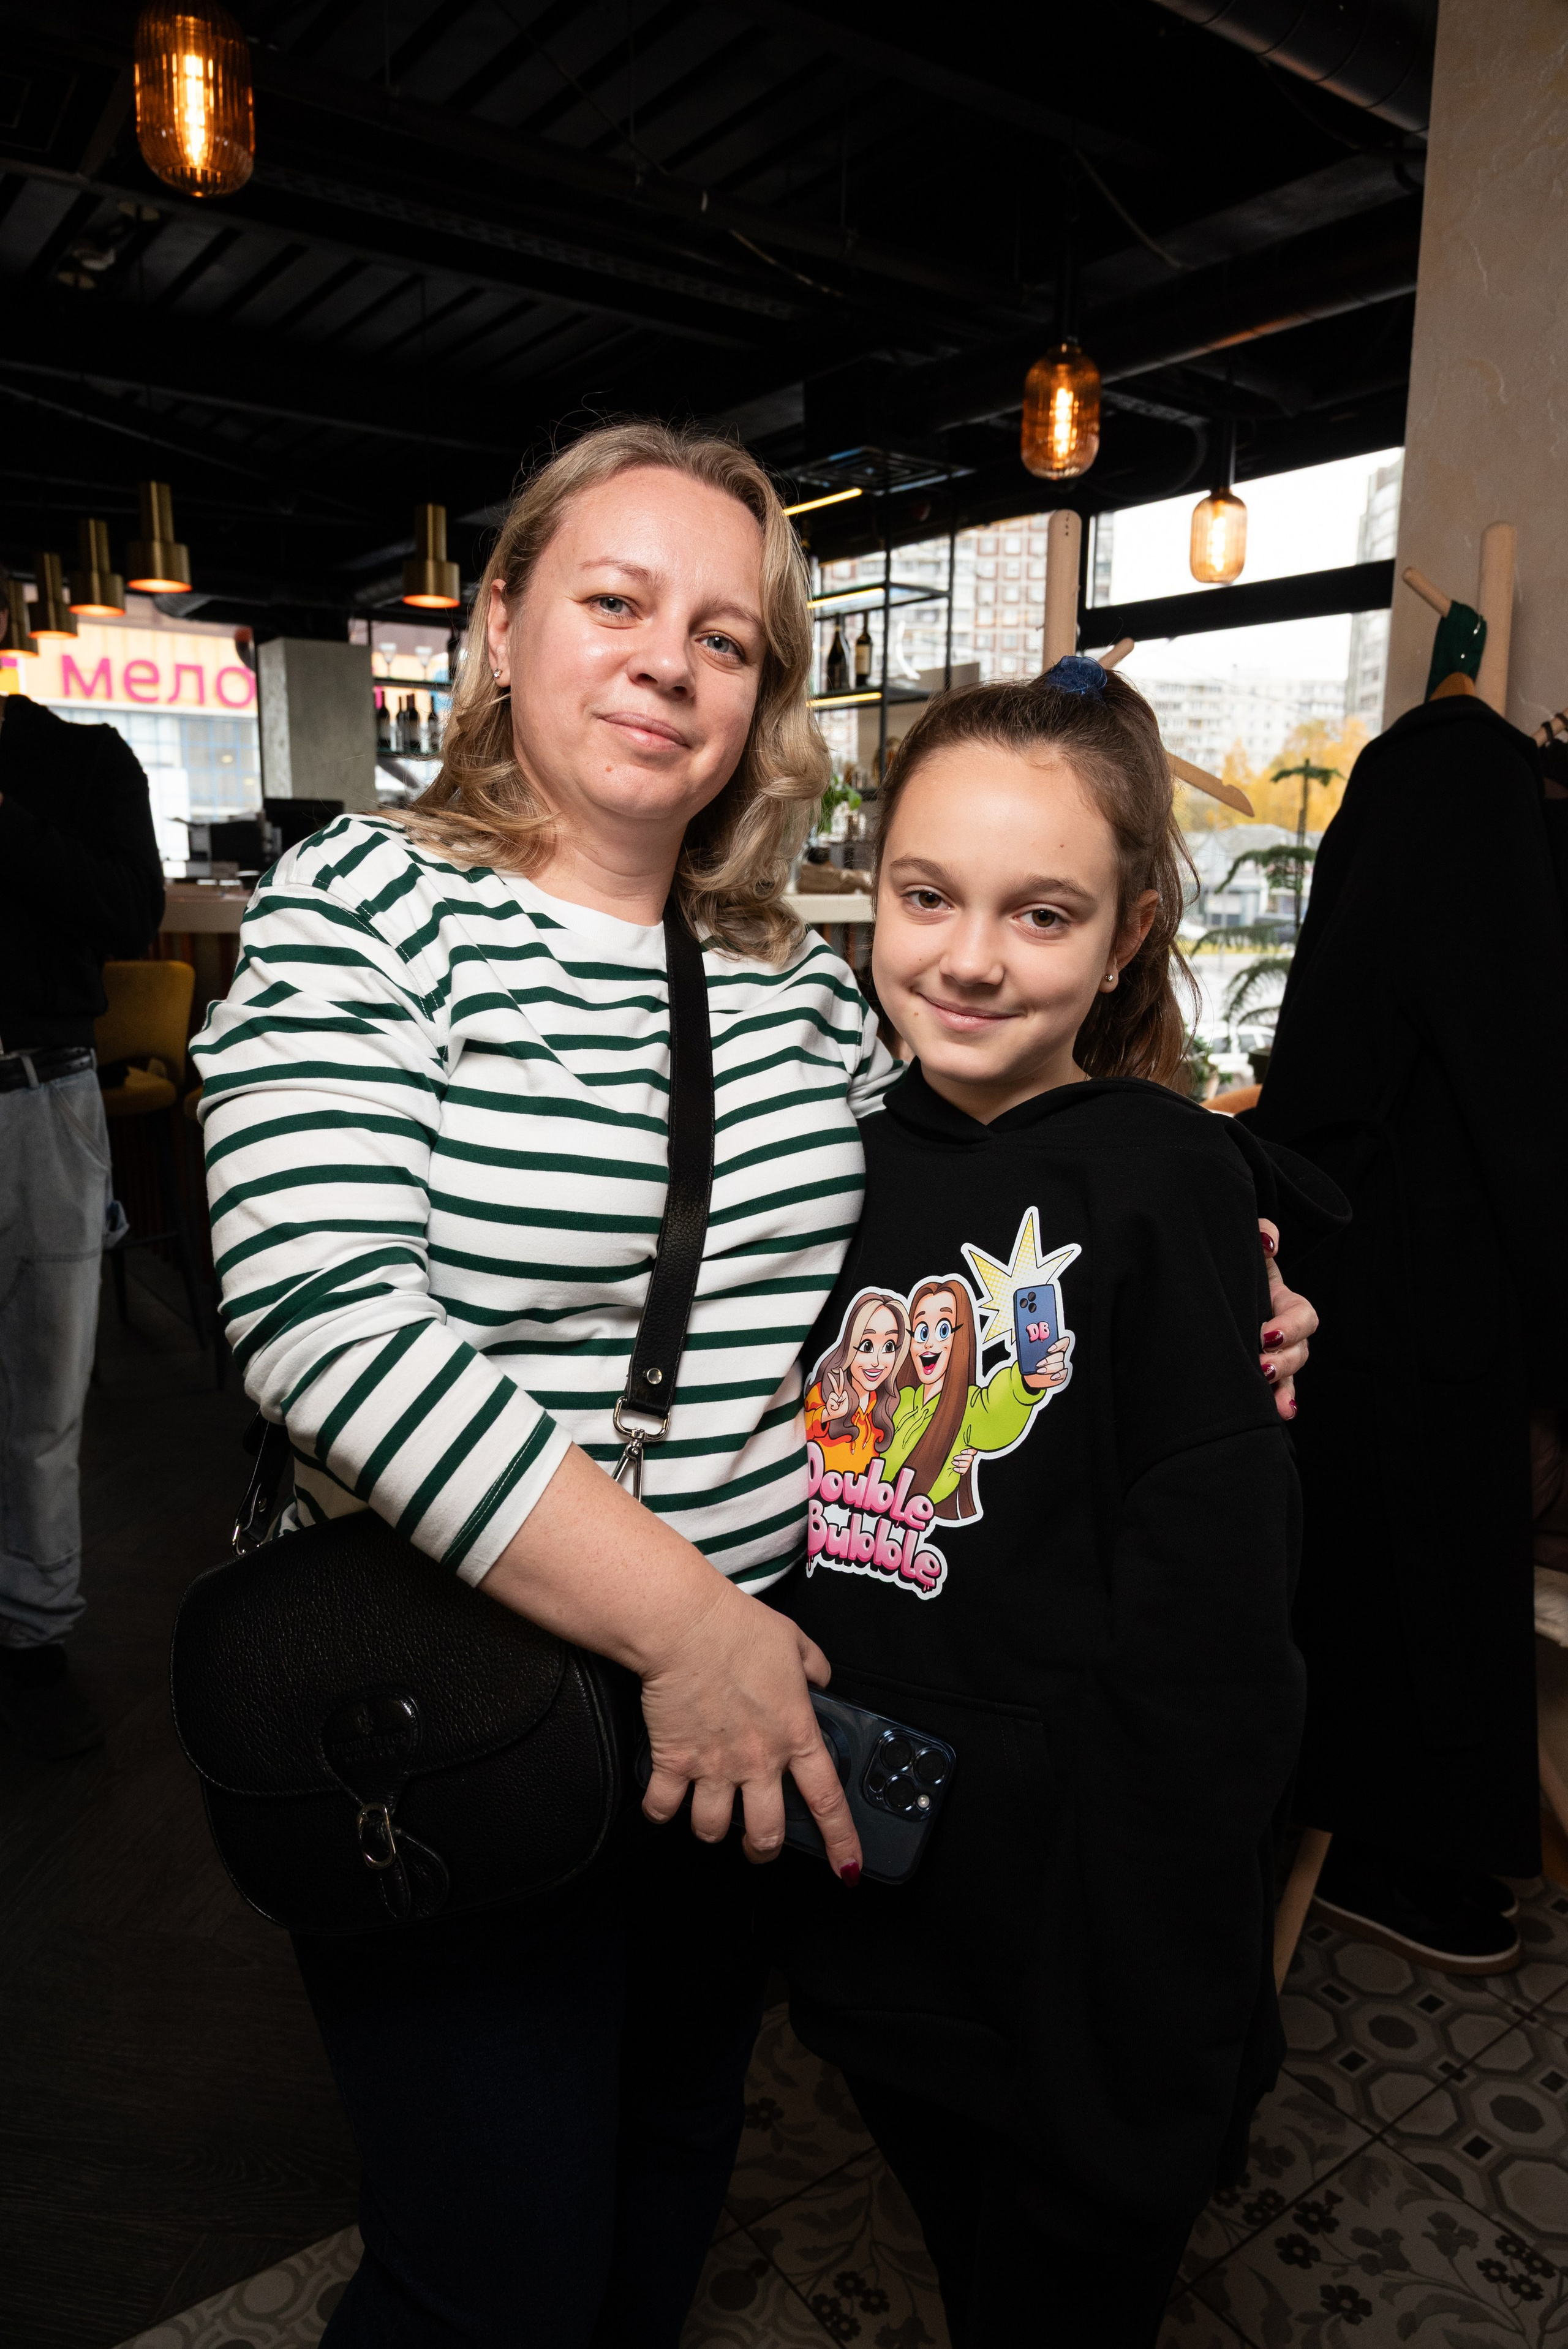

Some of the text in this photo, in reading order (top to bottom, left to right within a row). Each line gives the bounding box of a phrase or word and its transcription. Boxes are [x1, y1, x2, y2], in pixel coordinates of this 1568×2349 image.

[61, 655, 257, 708] мело
[1026, 1321, 1050, 1342] DB
[807, 1441, 934, 1530] Double
[808, 1499, 941, 1588] Bubble
